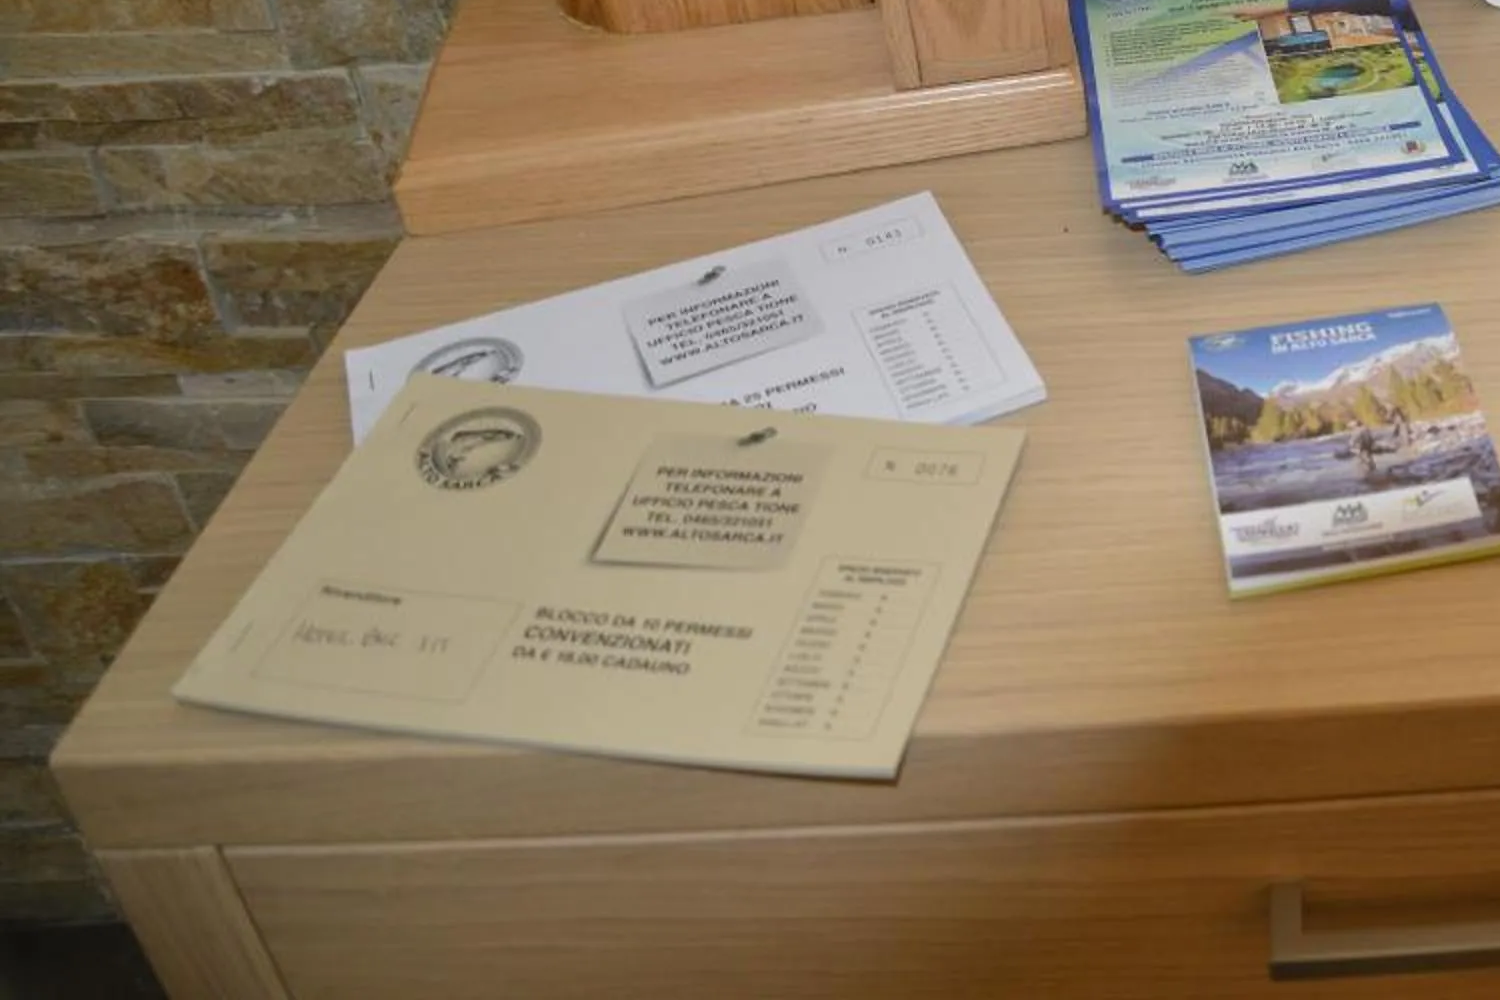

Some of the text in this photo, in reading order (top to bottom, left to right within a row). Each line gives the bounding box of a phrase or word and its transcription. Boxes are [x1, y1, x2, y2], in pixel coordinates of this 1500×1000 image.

[680, 279, 781, 316] INFORMAZIONI
[647, 294, 799, 348] UFFICIO PESCA TIONE
[667, 298, 760, 331] TELEFONARE
[1270, 321, 1373, 345] FISHING
[765, 366, 846, 396] PERMESSI
[656, 466, 804, 484] PER INFORMAZIONI
[666, 482, 767, 498] TELEFONARE
[632, 495, 801, 515] UFFICIO PESCA TIONE
[622, 526, 785, 544] WWW.ALTOSARCA.IT
[535, 606, 610, 626] BLOCCO
[612, 613, 636, 629] DA
[664, 620, 753, 641] PERMESSI
[524, 625, 692, 656] CONVENZIONATI
[512, 645, 536, 660] DA
[602, 652, 692, 676] CADAUNO
